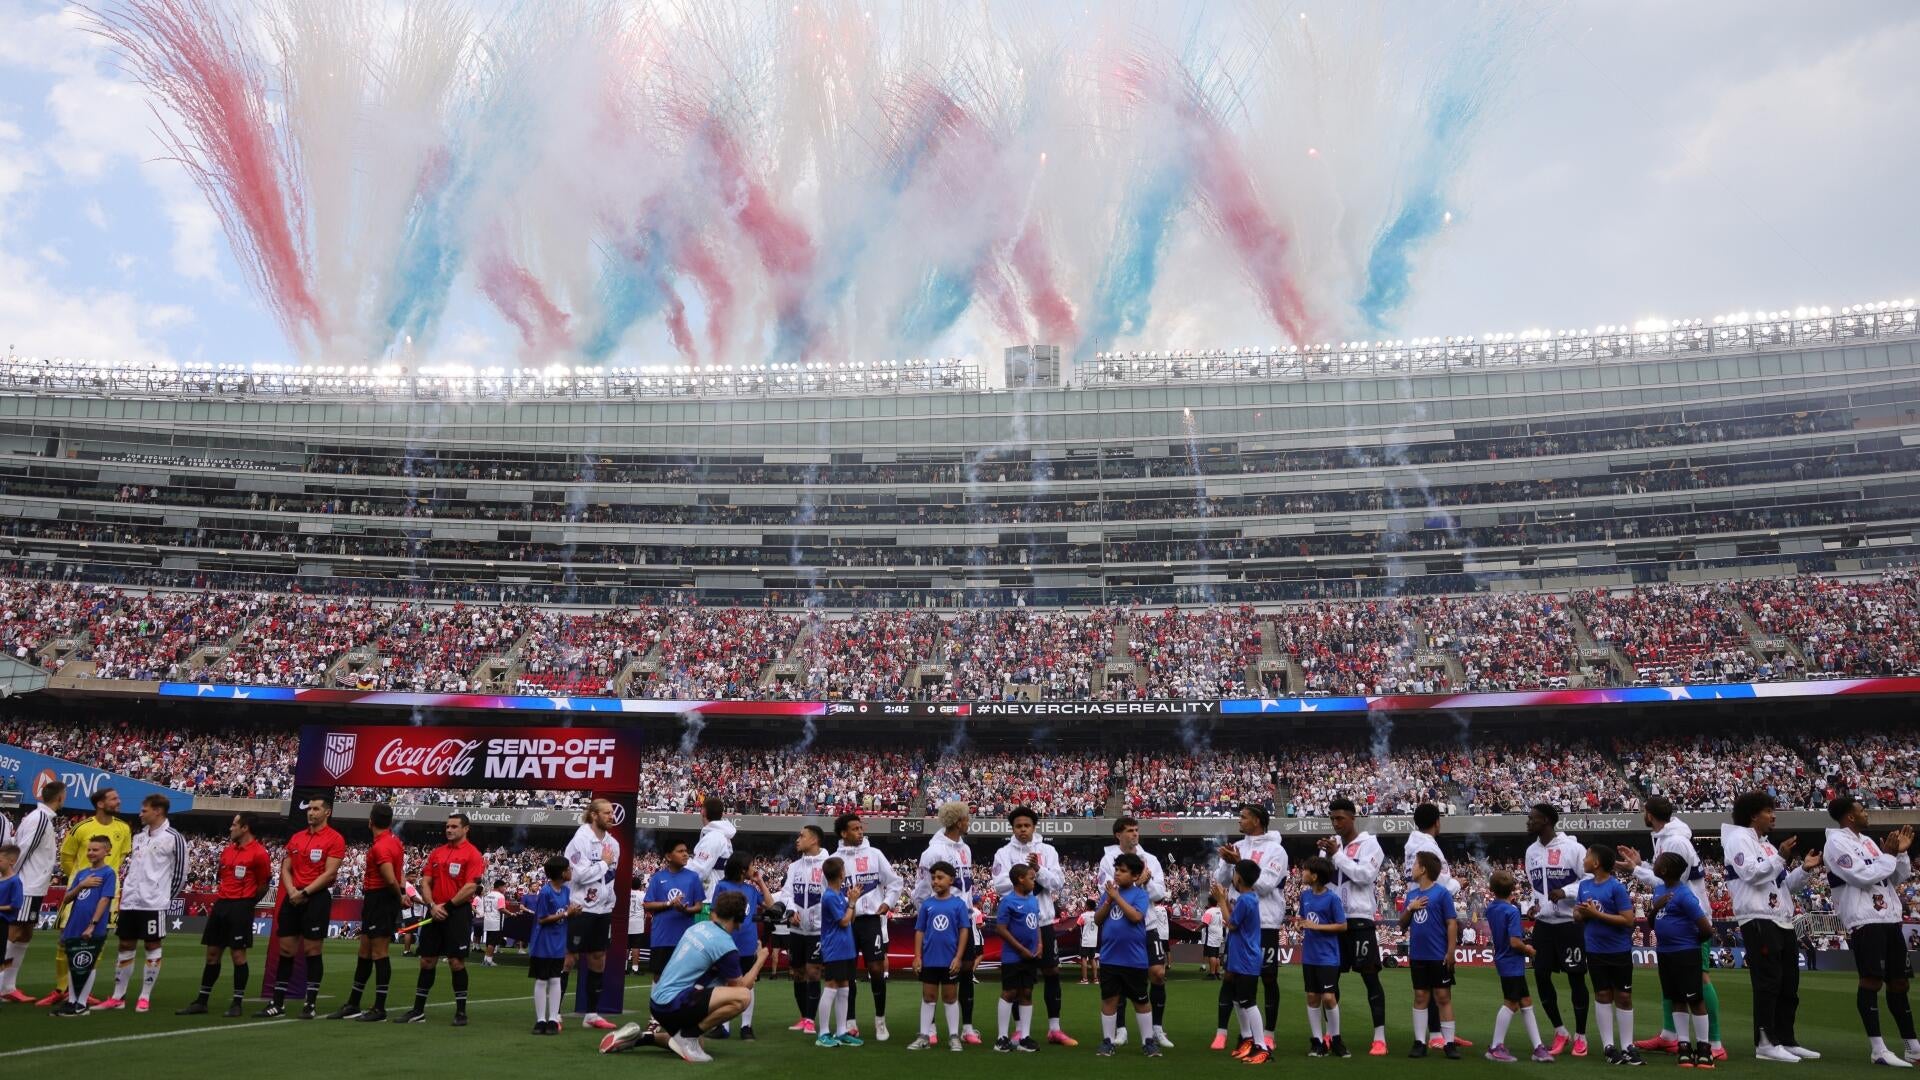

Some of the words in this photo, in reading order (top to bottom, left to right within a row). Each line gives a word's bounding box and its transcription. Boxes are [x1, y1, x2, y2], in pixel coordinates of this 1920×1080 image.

[836, 704, 855, 713] USA
[884, 704, 910, 714] 2:45
[939, 704, 959, 713] GER
[976, 702, 1215, 714] #NEVERCHASEREALITY
[327, 734, 355, 754] USA
[487, 738, 616, 755] SEND-OFF
[484, 756, 614, 779] MATCH
[60, 772, 111, 798] PNC
[466, 810, 511, 822] Advocate
[899, 820, 922, 832] 2:45
[1034, 821, 1074, 833] FIELD
[147, 919, 157, 935] 6
[874, 934, 882, 949] 4
[1355, 940, 1370, 957] 16
[1565, 947, 1582, 963] 20
